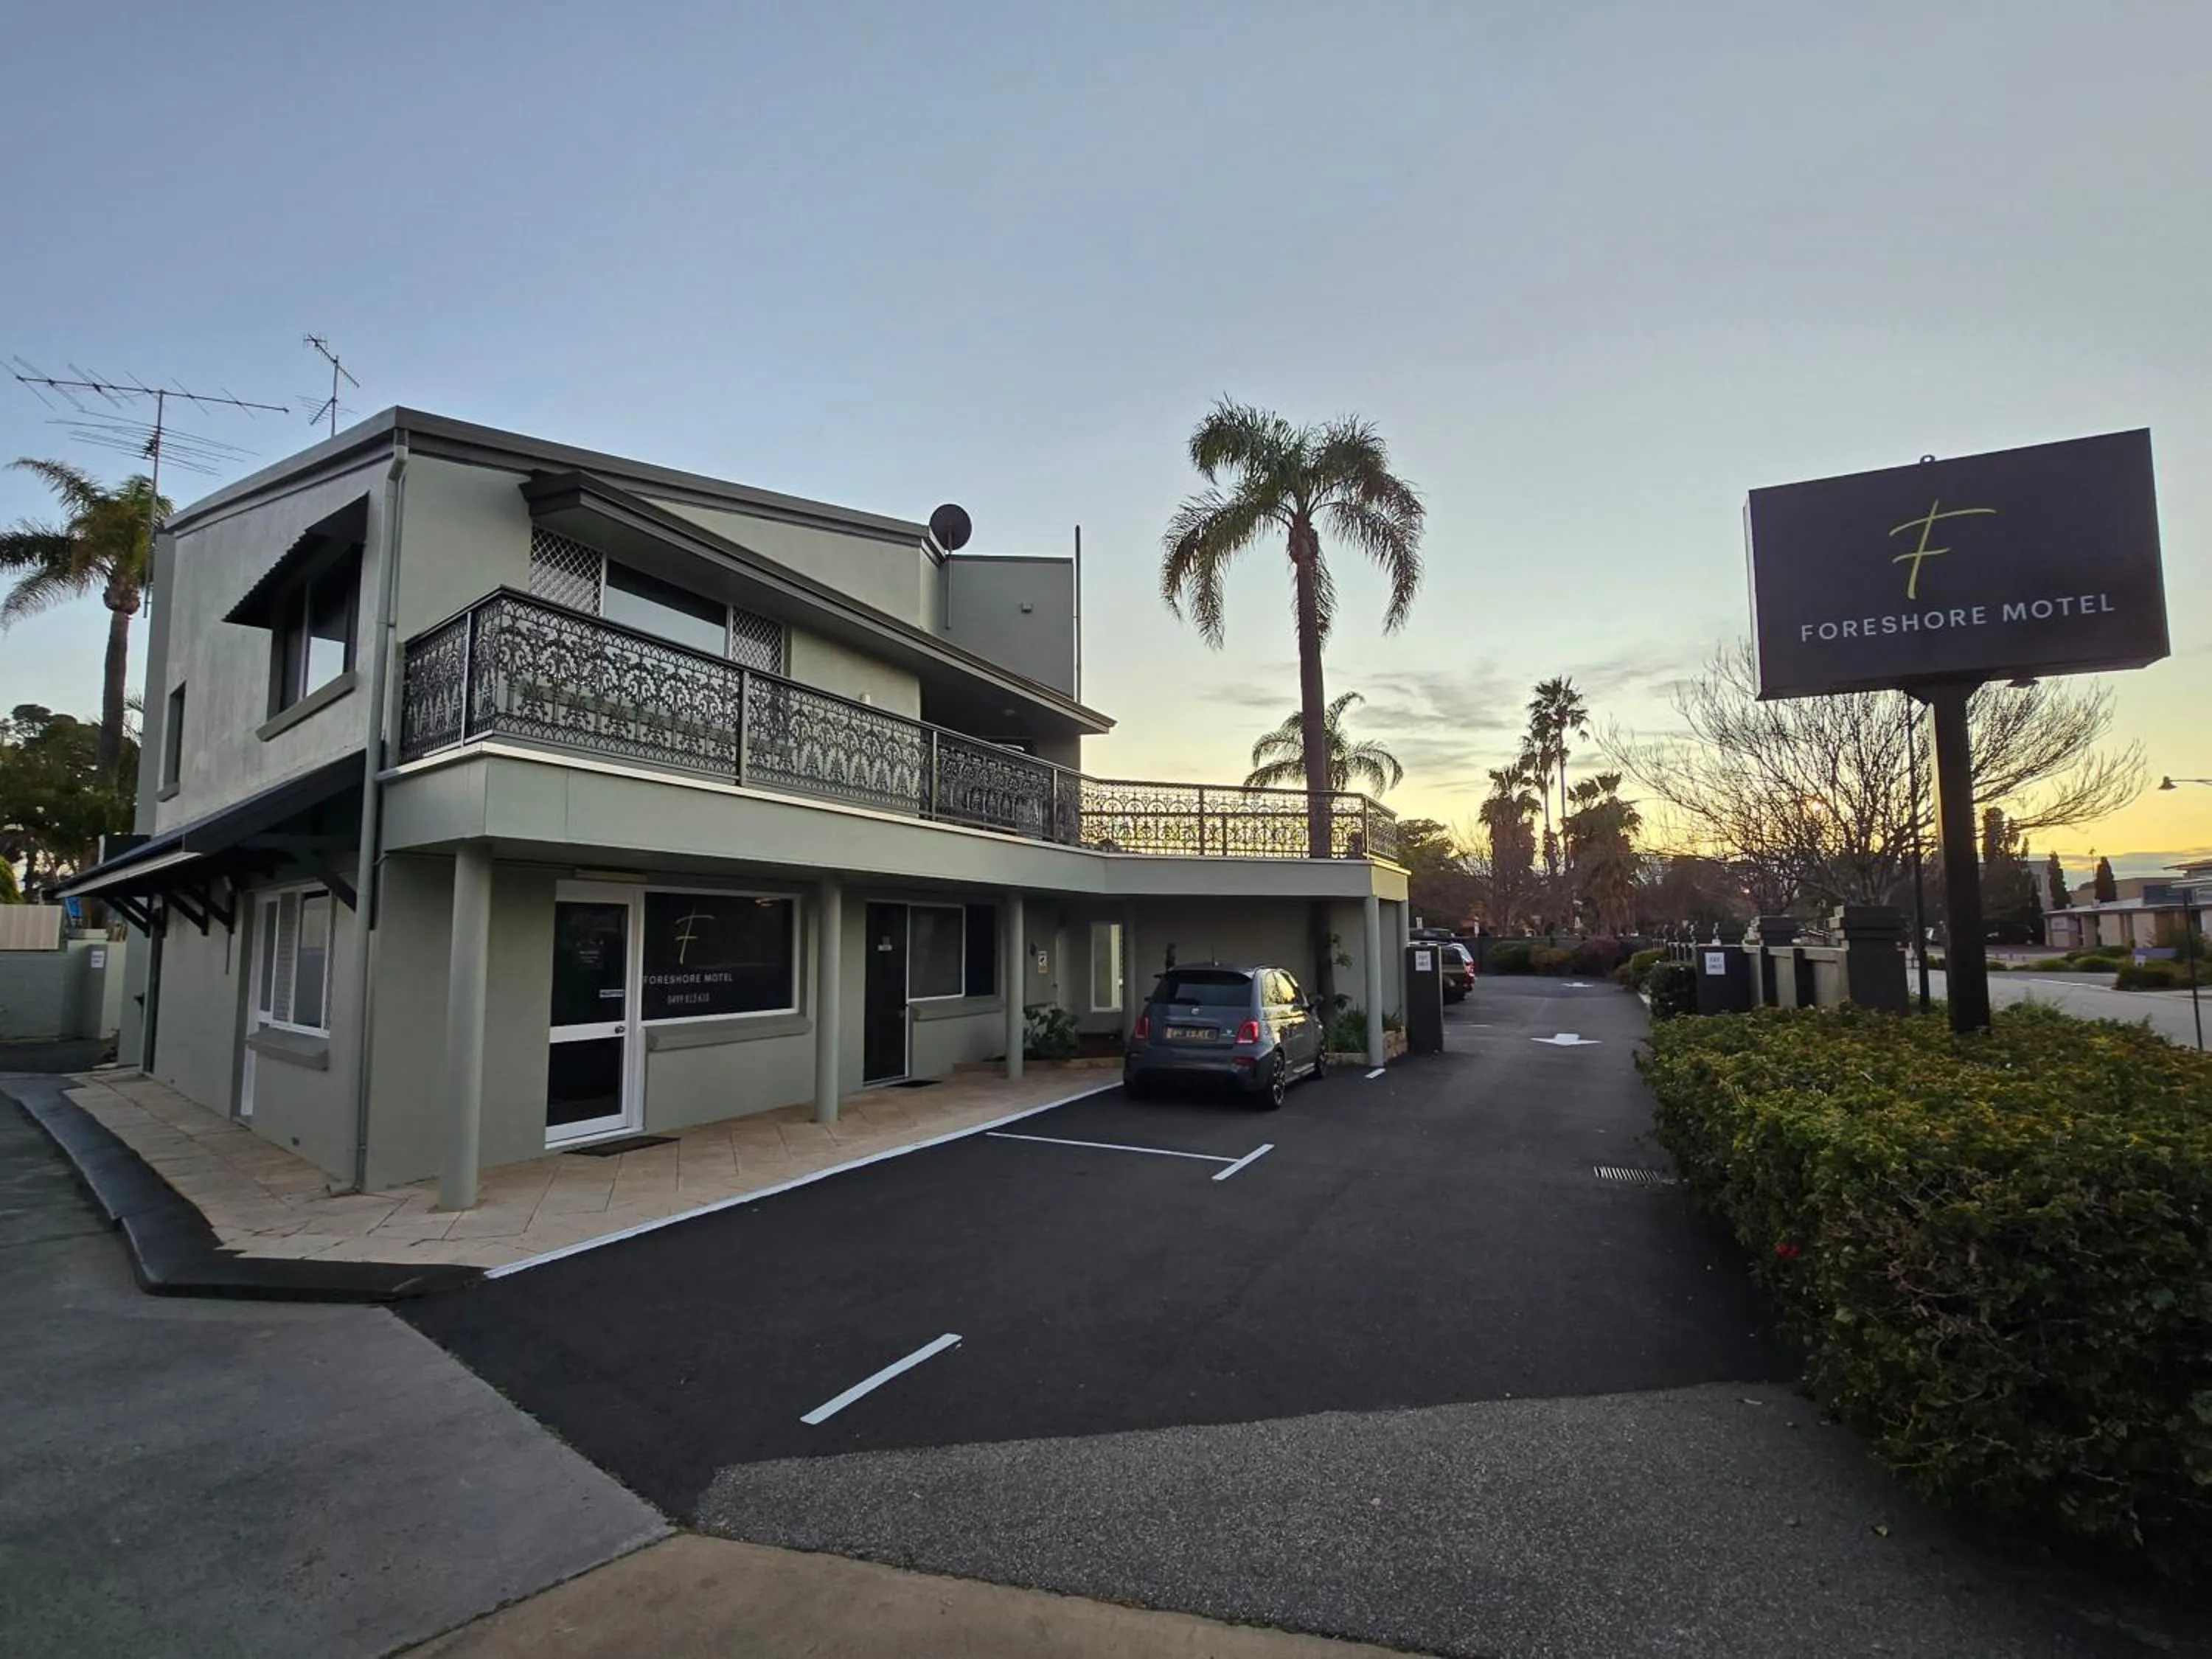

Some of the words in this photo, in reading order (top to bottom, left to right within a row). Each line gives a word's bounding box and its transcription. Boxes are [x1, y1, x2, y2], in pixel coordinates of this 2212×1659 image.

[1889, 499, 1997, 599] F
[1801, 607, 1986, 642] FORESHORE
[2002, 593, 2115, 623] MOTEL
[644, 973, 702, 985] FORESHORE
[704, 972, 733, 982] MOTEL
